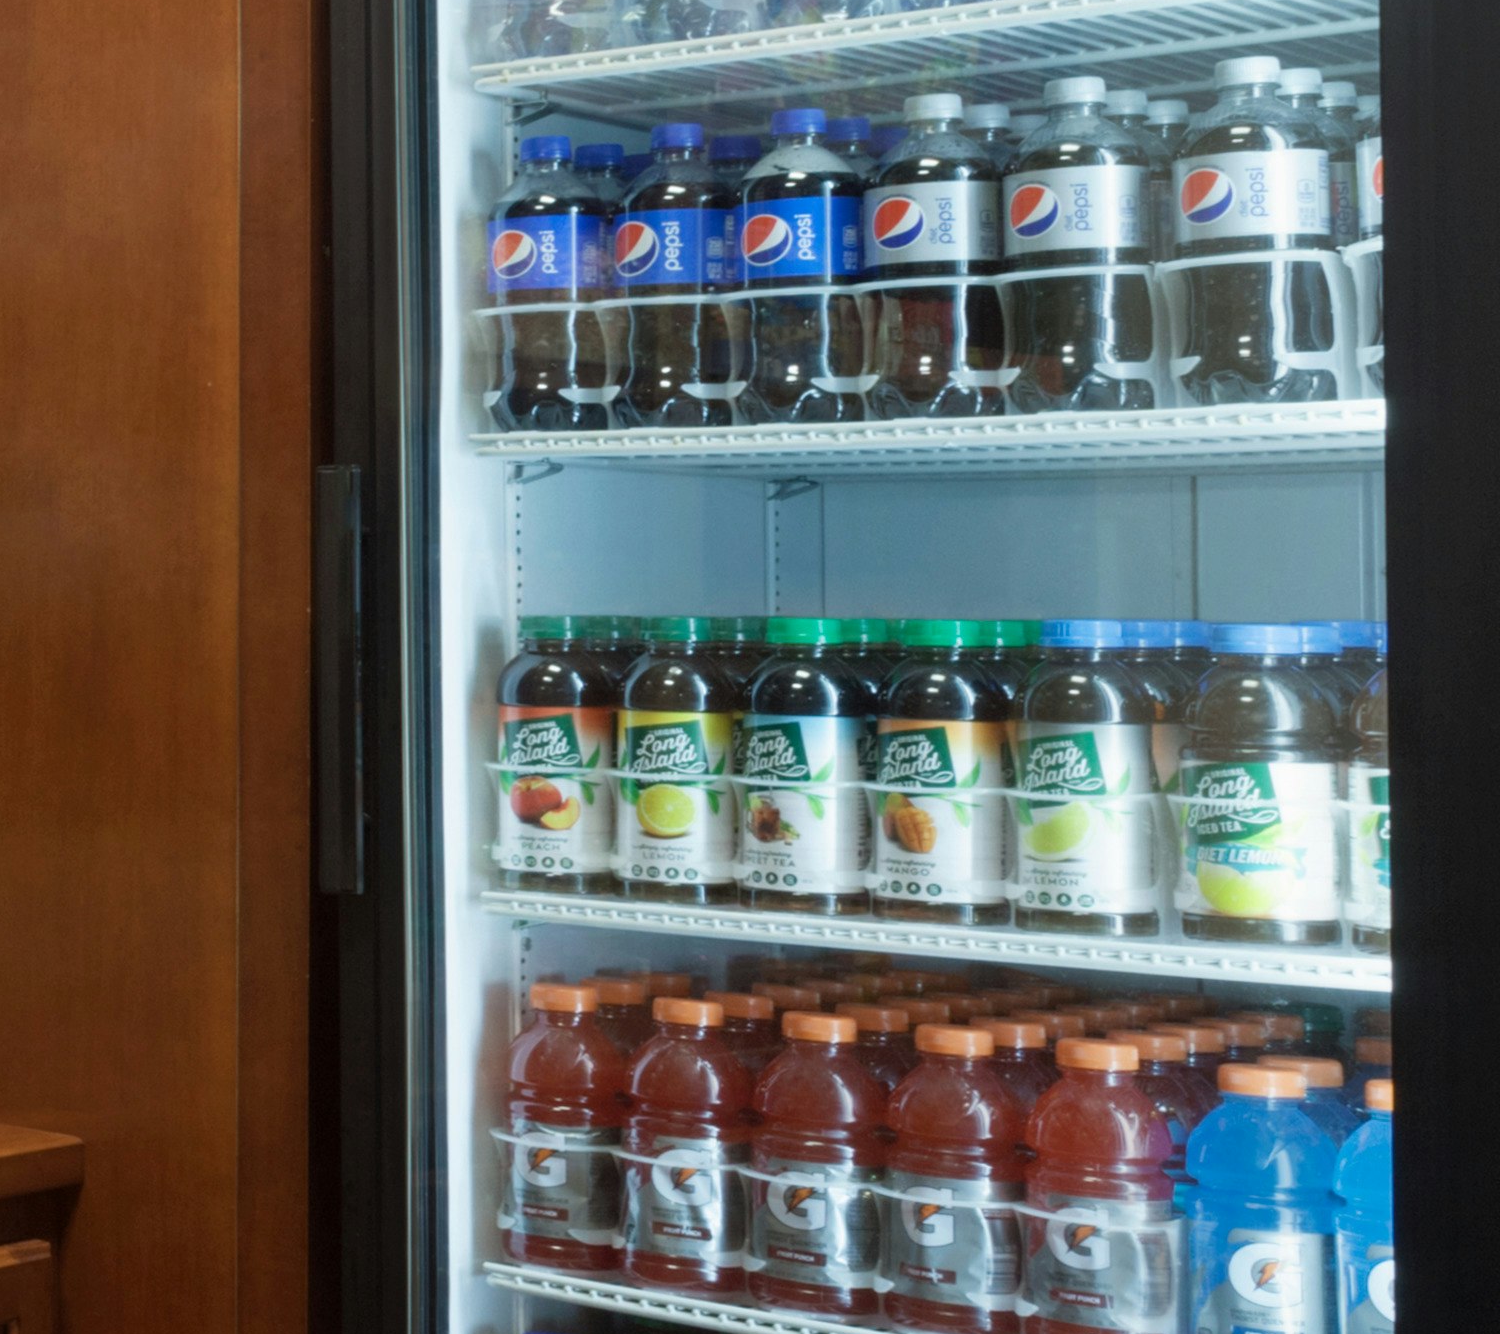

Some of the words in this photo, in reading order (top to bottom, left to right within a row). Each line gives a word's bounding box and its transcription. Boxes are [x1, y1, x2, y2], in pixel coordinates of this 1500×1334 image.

[1248, 166, 1267, 218] pepsi
[664, 220, 682, 272] pepsi
[798, 213, 814, 261] pepsi
[640, 731, 690, 757] Long
[642, 852, 686, 863] LEMON
[1198, 846, 1227, 863] DIET
